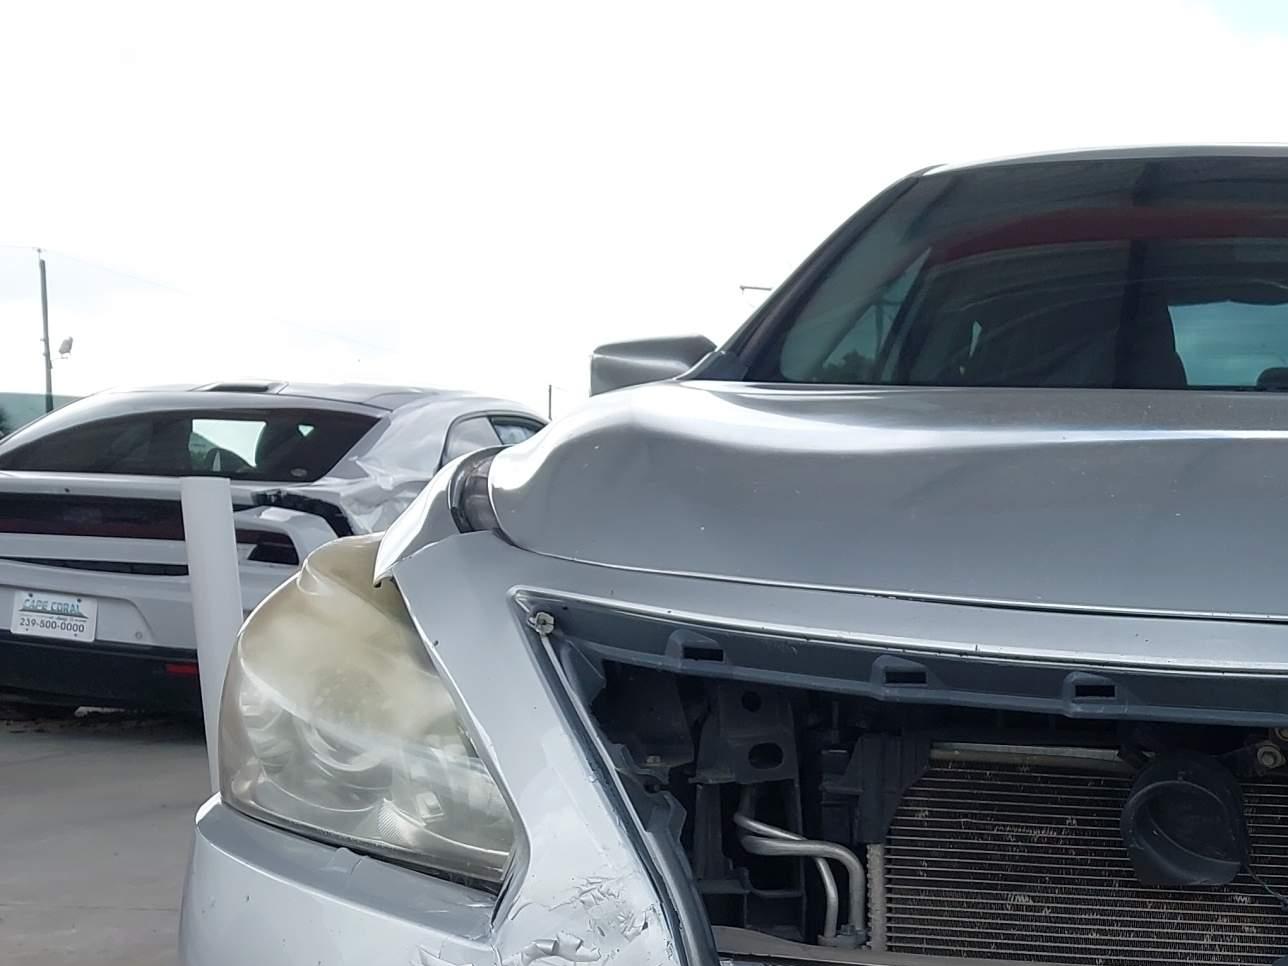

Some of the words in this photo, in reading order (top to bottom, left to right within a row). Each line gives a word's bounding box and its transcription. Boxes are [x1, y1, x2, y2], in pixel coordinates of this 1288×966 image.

[23, 598, 49, 610] CAPE
[50, 601, 81, 615] CORAL
[19, 617, 86, 633] 239-500-0000
